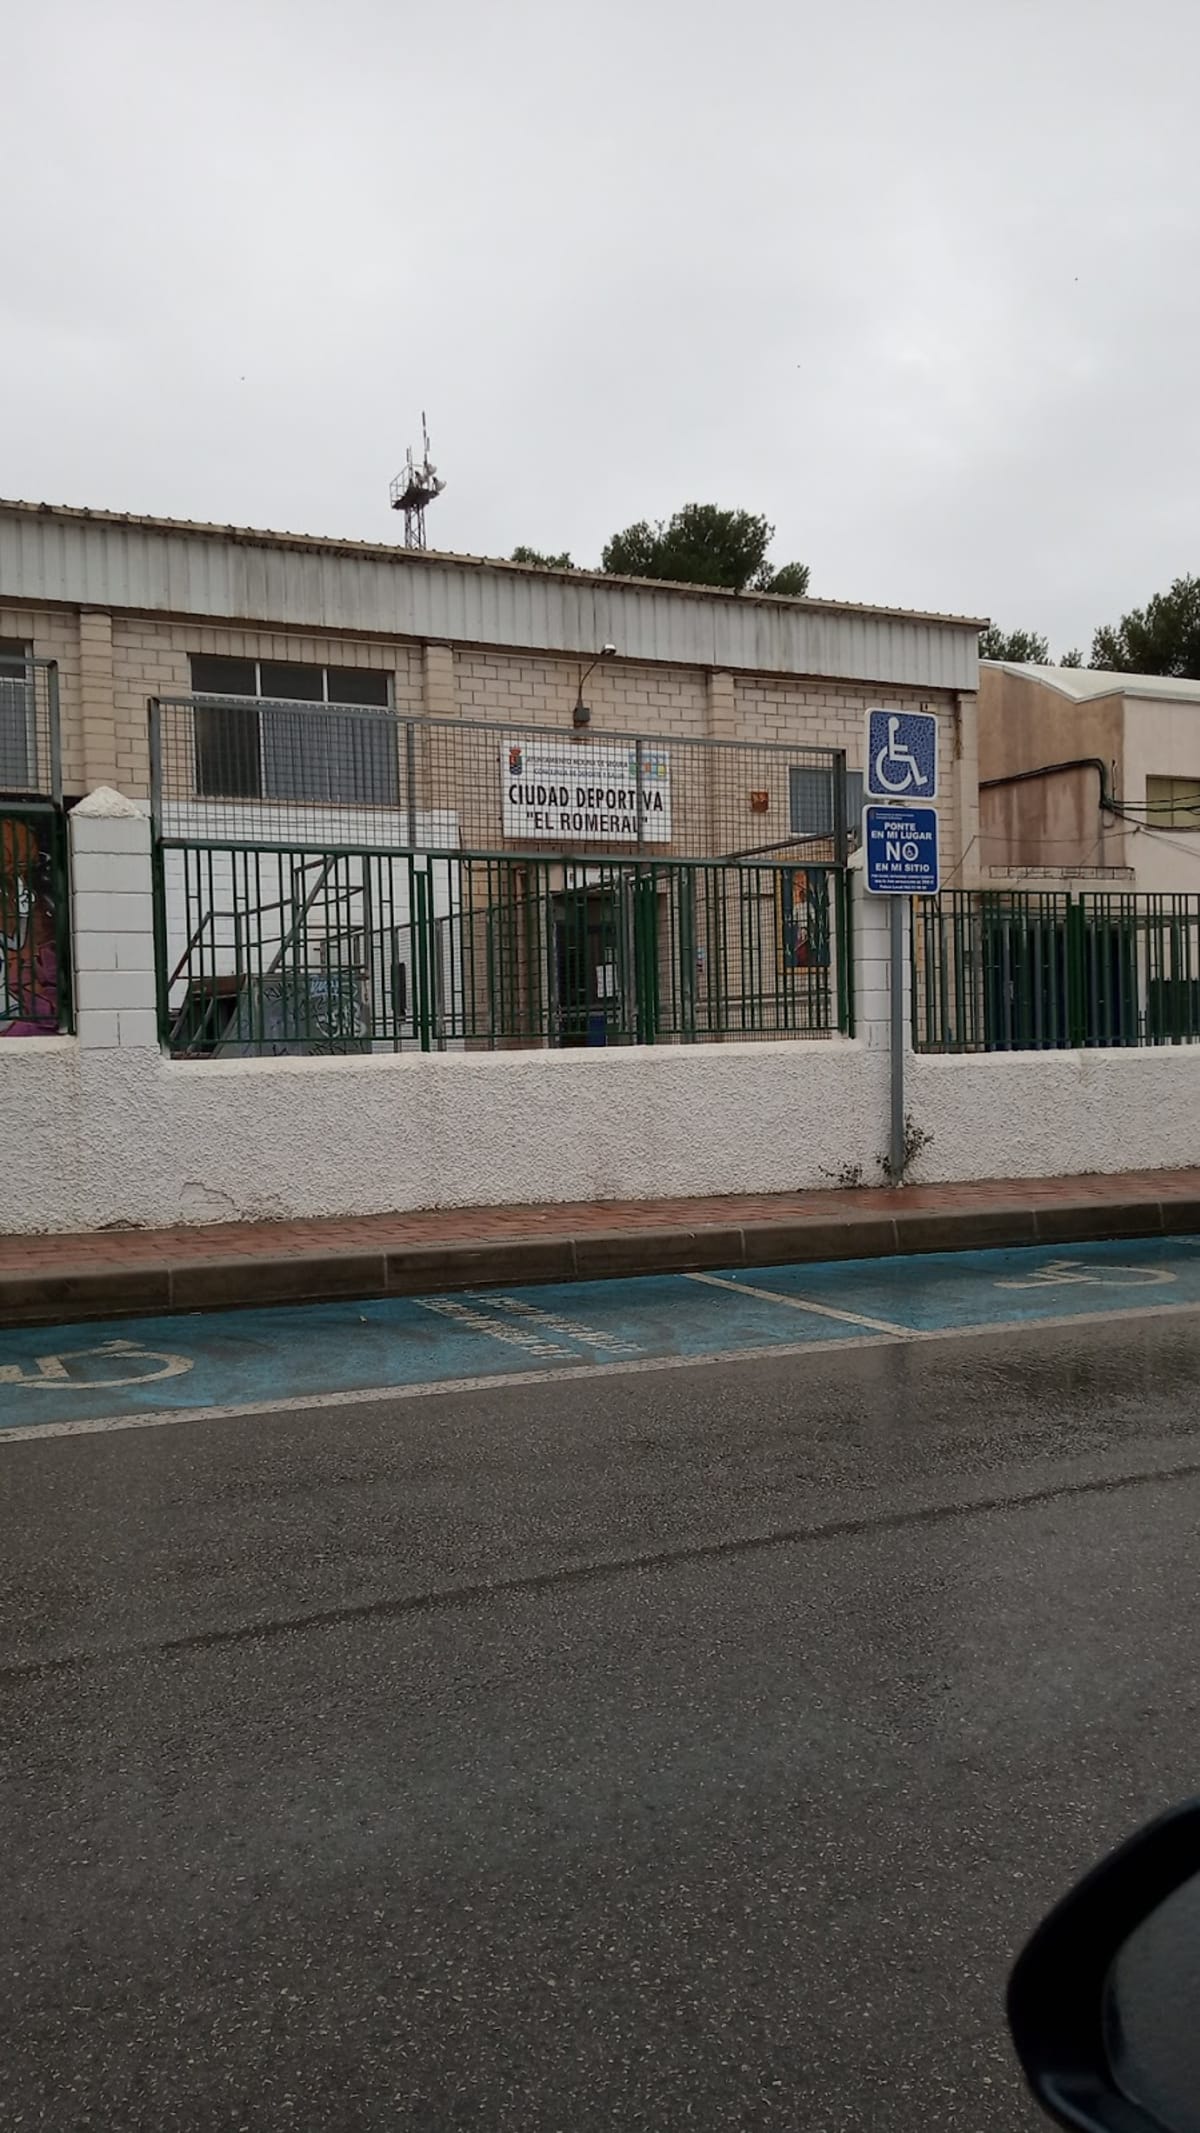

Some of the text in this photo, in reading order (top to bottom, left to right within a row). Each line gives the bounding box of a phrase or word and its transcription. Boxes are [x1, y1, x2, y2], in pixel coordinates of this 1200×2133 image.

[509, 784, 663, 812] CIUDAD DEPORTVA
[526, 811, 554, 830] "EL
[884, 822, 916, 831] PONTE
[871, 830, 932, 840] EN MI LUGAR
[886, 841, 919, 861] NO
[875, 863, 930, 872] EN MI SITIO
